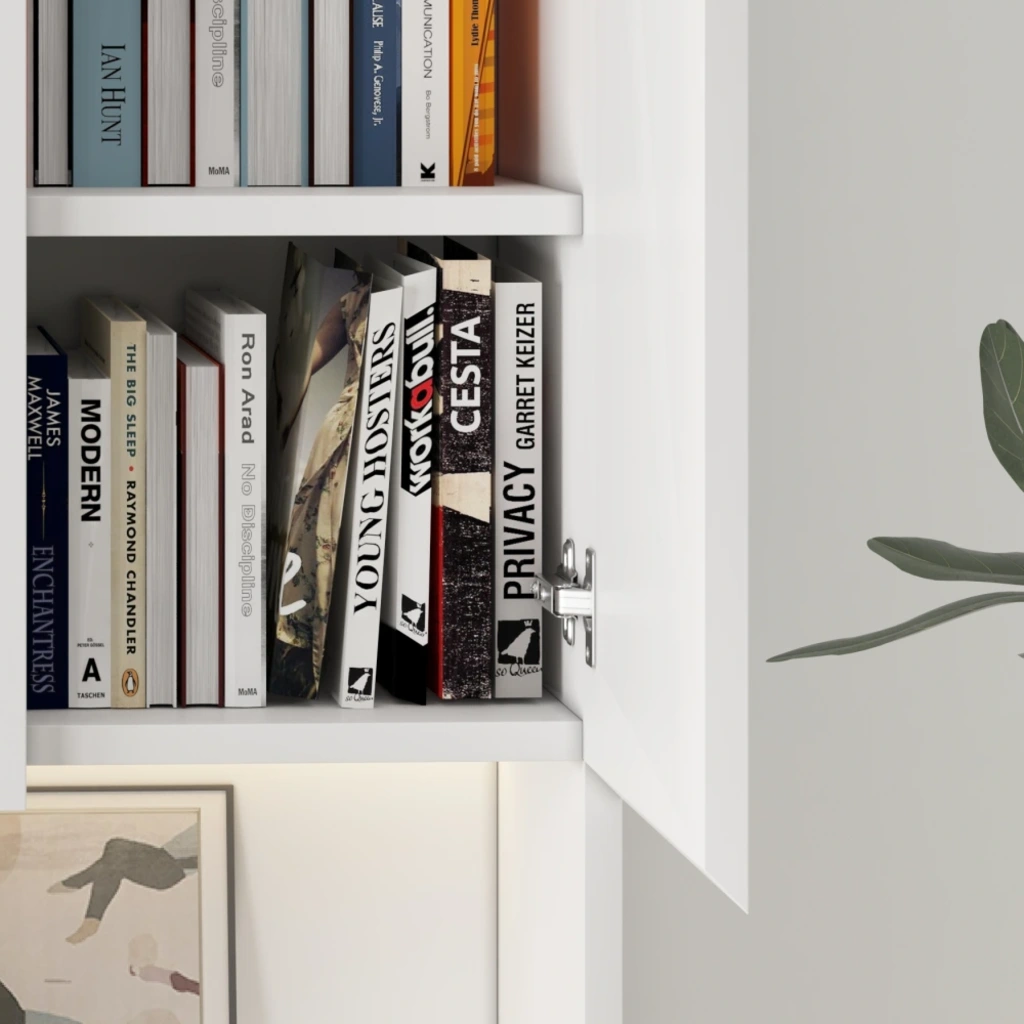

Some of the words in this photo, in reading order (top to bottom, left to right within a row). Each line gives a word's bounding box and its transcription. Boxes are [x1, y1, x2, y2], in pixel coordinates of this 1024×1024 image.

[372, 76, 383, 115] Genovese,
[374, 64, 382, 73] A.
[372, 118, 383, 126] Jr.
[209, 167, 230, 175] MoMA
[127, 344, 136, 372] THE
[242, 334, 255, 379] Ron
[516, 303, 534, 367] KEIZER
[127, 380, 136, 406] BIG
[363, 322, 396, 479] HOSTERS
[450, 316, 483, 434] CESTA
[27, 375, 43, 461] MAXWELL
[46, 389, 61, 446] JAMES
[127, 415, 136, 457] SLEEP
[242, 389, 255, 443] Arad
[516, 375, 535, 449] GARRET
[81, 400, 101, 521] MODERN
[240, 462, 256, 497] No
[127, 481, 136, 563] RAYMOND
[353, 488, 387, 613] YOUNG
[502, 460, 536, 601] PRIVACY
[238, 504, 256, 617] Discipline
[30, 545, 56, 694] ENCHANTRESS
[127, 570, 136, 654] CHANDLER
[82, 658, 101, 682] A
